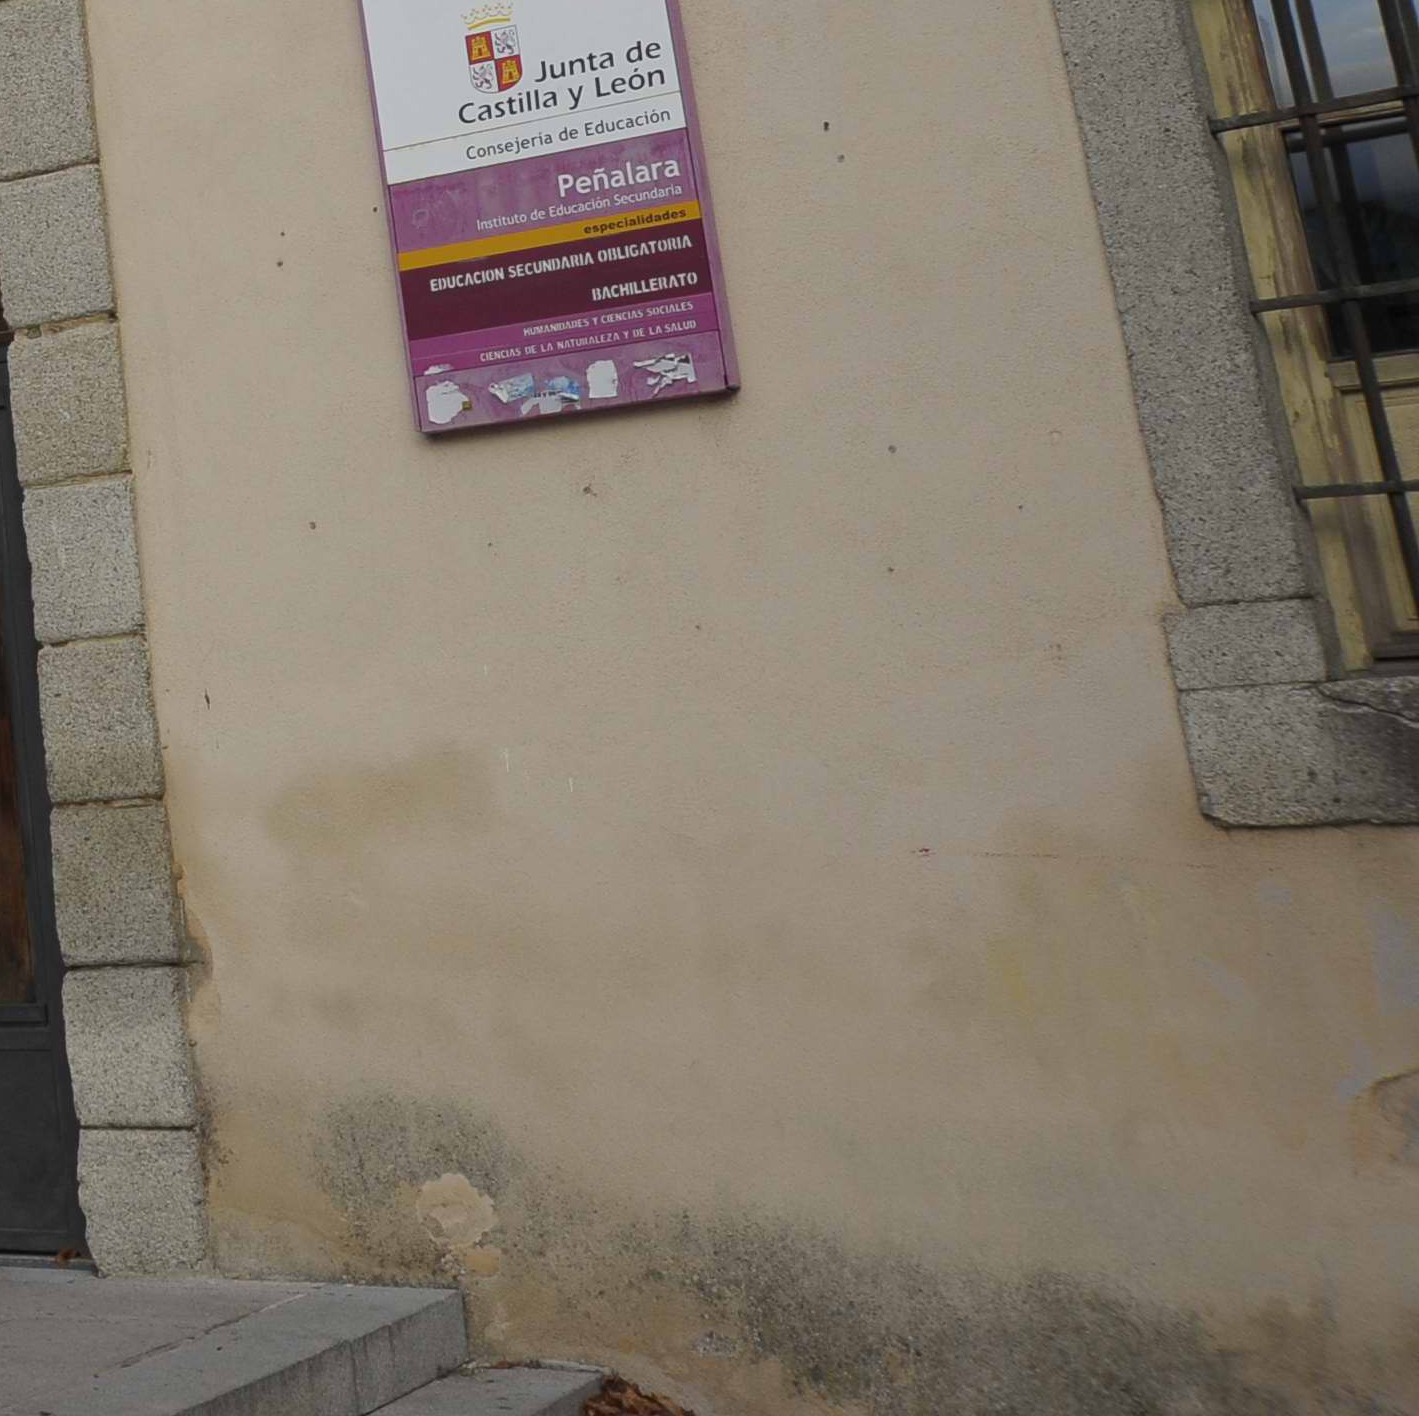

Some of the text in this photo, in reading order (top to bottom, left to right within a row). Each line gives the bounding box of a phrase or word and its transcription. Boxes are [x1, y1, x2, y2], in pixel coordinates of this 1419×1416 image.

[535, 41, 661, 83] Junta de
[458, 67, 666, 124] Castilla y León
[558, 126, 579, 142] de
[584, 109, 671, 137] Educación
[558, 159, 681, 198] Peñalara
[477, 184, 683, 231] Instituto de Educación Secundaria
[584, 208, 687, 235] especialidades
[507, 252, 594, 278] SECUNDARIA
[598, 234, 692, 263] OBLIGATORIA
[591, 271, 698, 301] BACHILLERATO
[523, 301, 694, 337] HUMANIDADES Y CIENCIAS SOCIALES
[480, 319, 697, 362] CIENCIAS DE LA NATURALEZA Y DE LA SALUD
